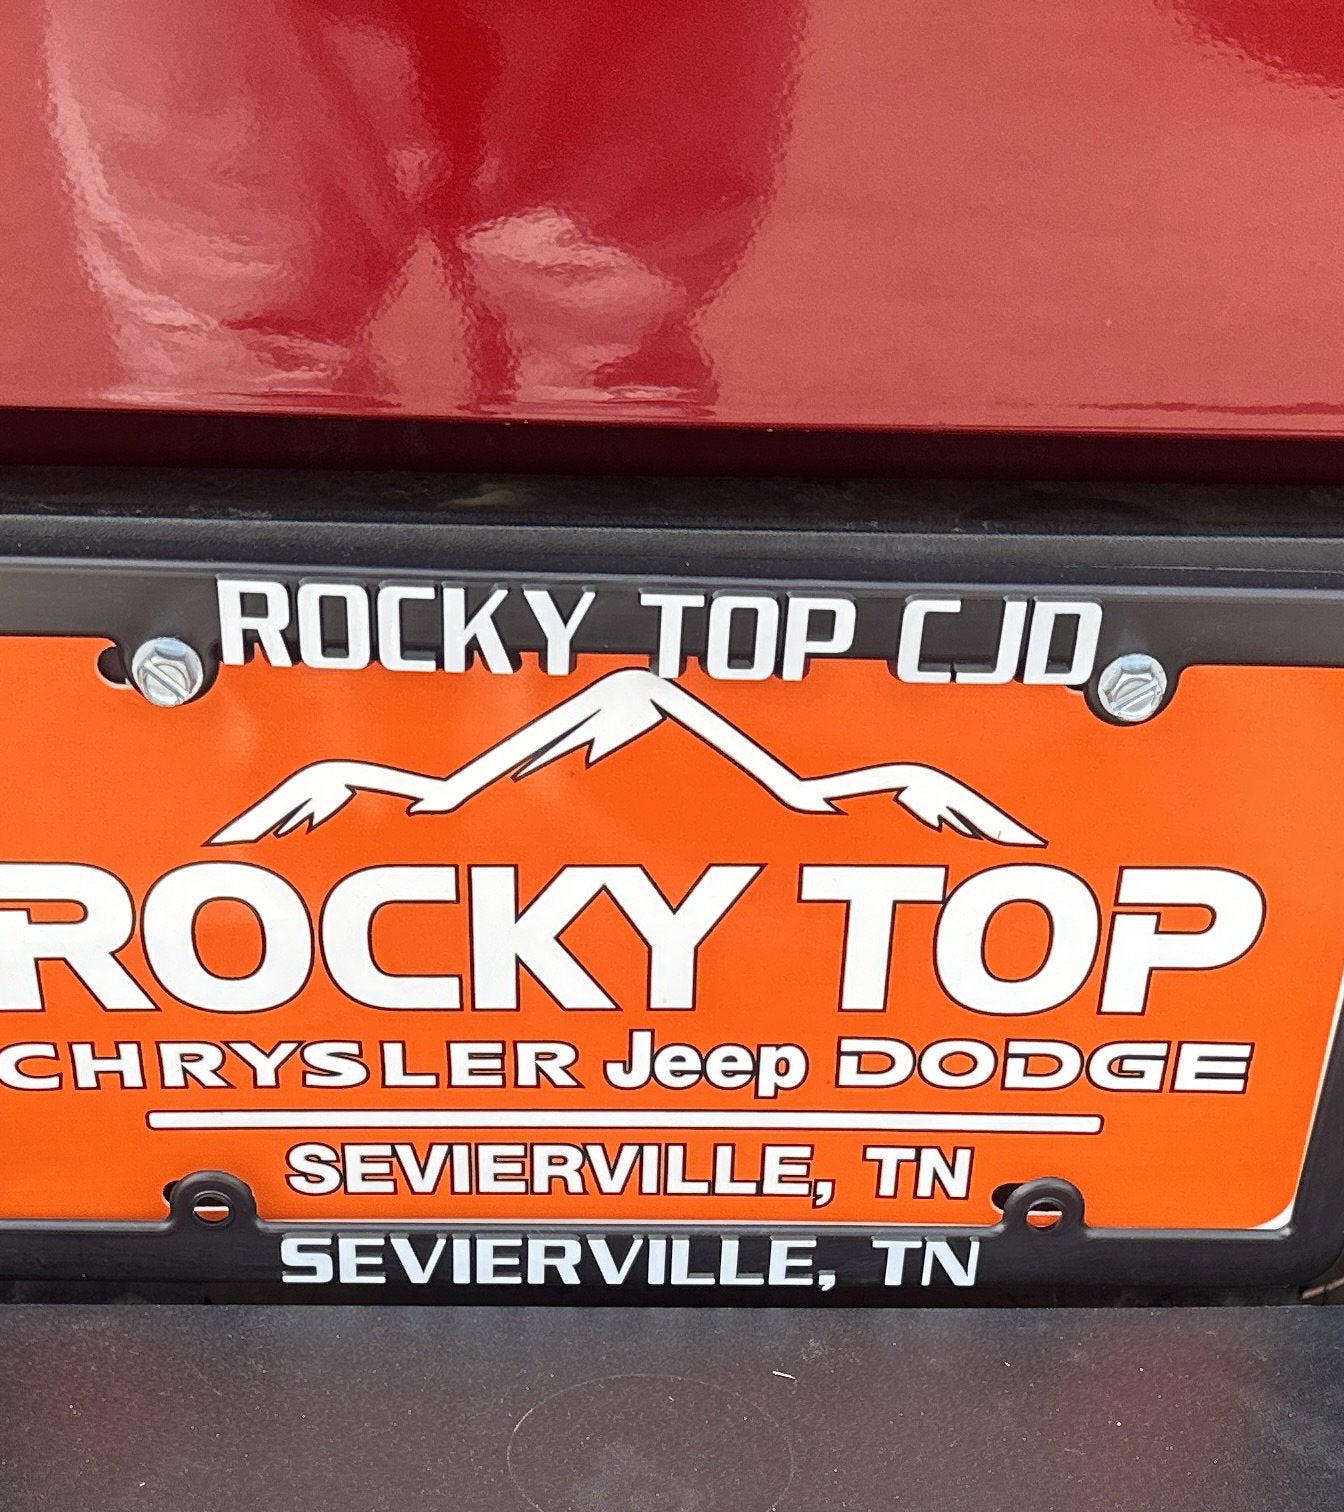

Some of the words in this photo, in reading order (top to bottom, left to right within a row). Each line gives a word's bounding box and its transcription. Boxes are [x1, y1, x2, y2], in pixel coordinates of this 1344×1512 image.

[216, 578, 596, 676] ROCKY
[640, 592, 857, 682] TOP
[896, 598, 1103, 685] CJD
[797, 862, 1268, 1018] TOP
[603, 1029, 809, 1100] Jeep
[834, 1035, 1255, 1095] DODGE
[285, 1142, 835, 1208] SEVIERVILLE,
[863, 1144, 975, 1200] TN
[280, 1236, 836, 1292] SEVIERVILLE,
[871, 1238, 981, 1287] TN
